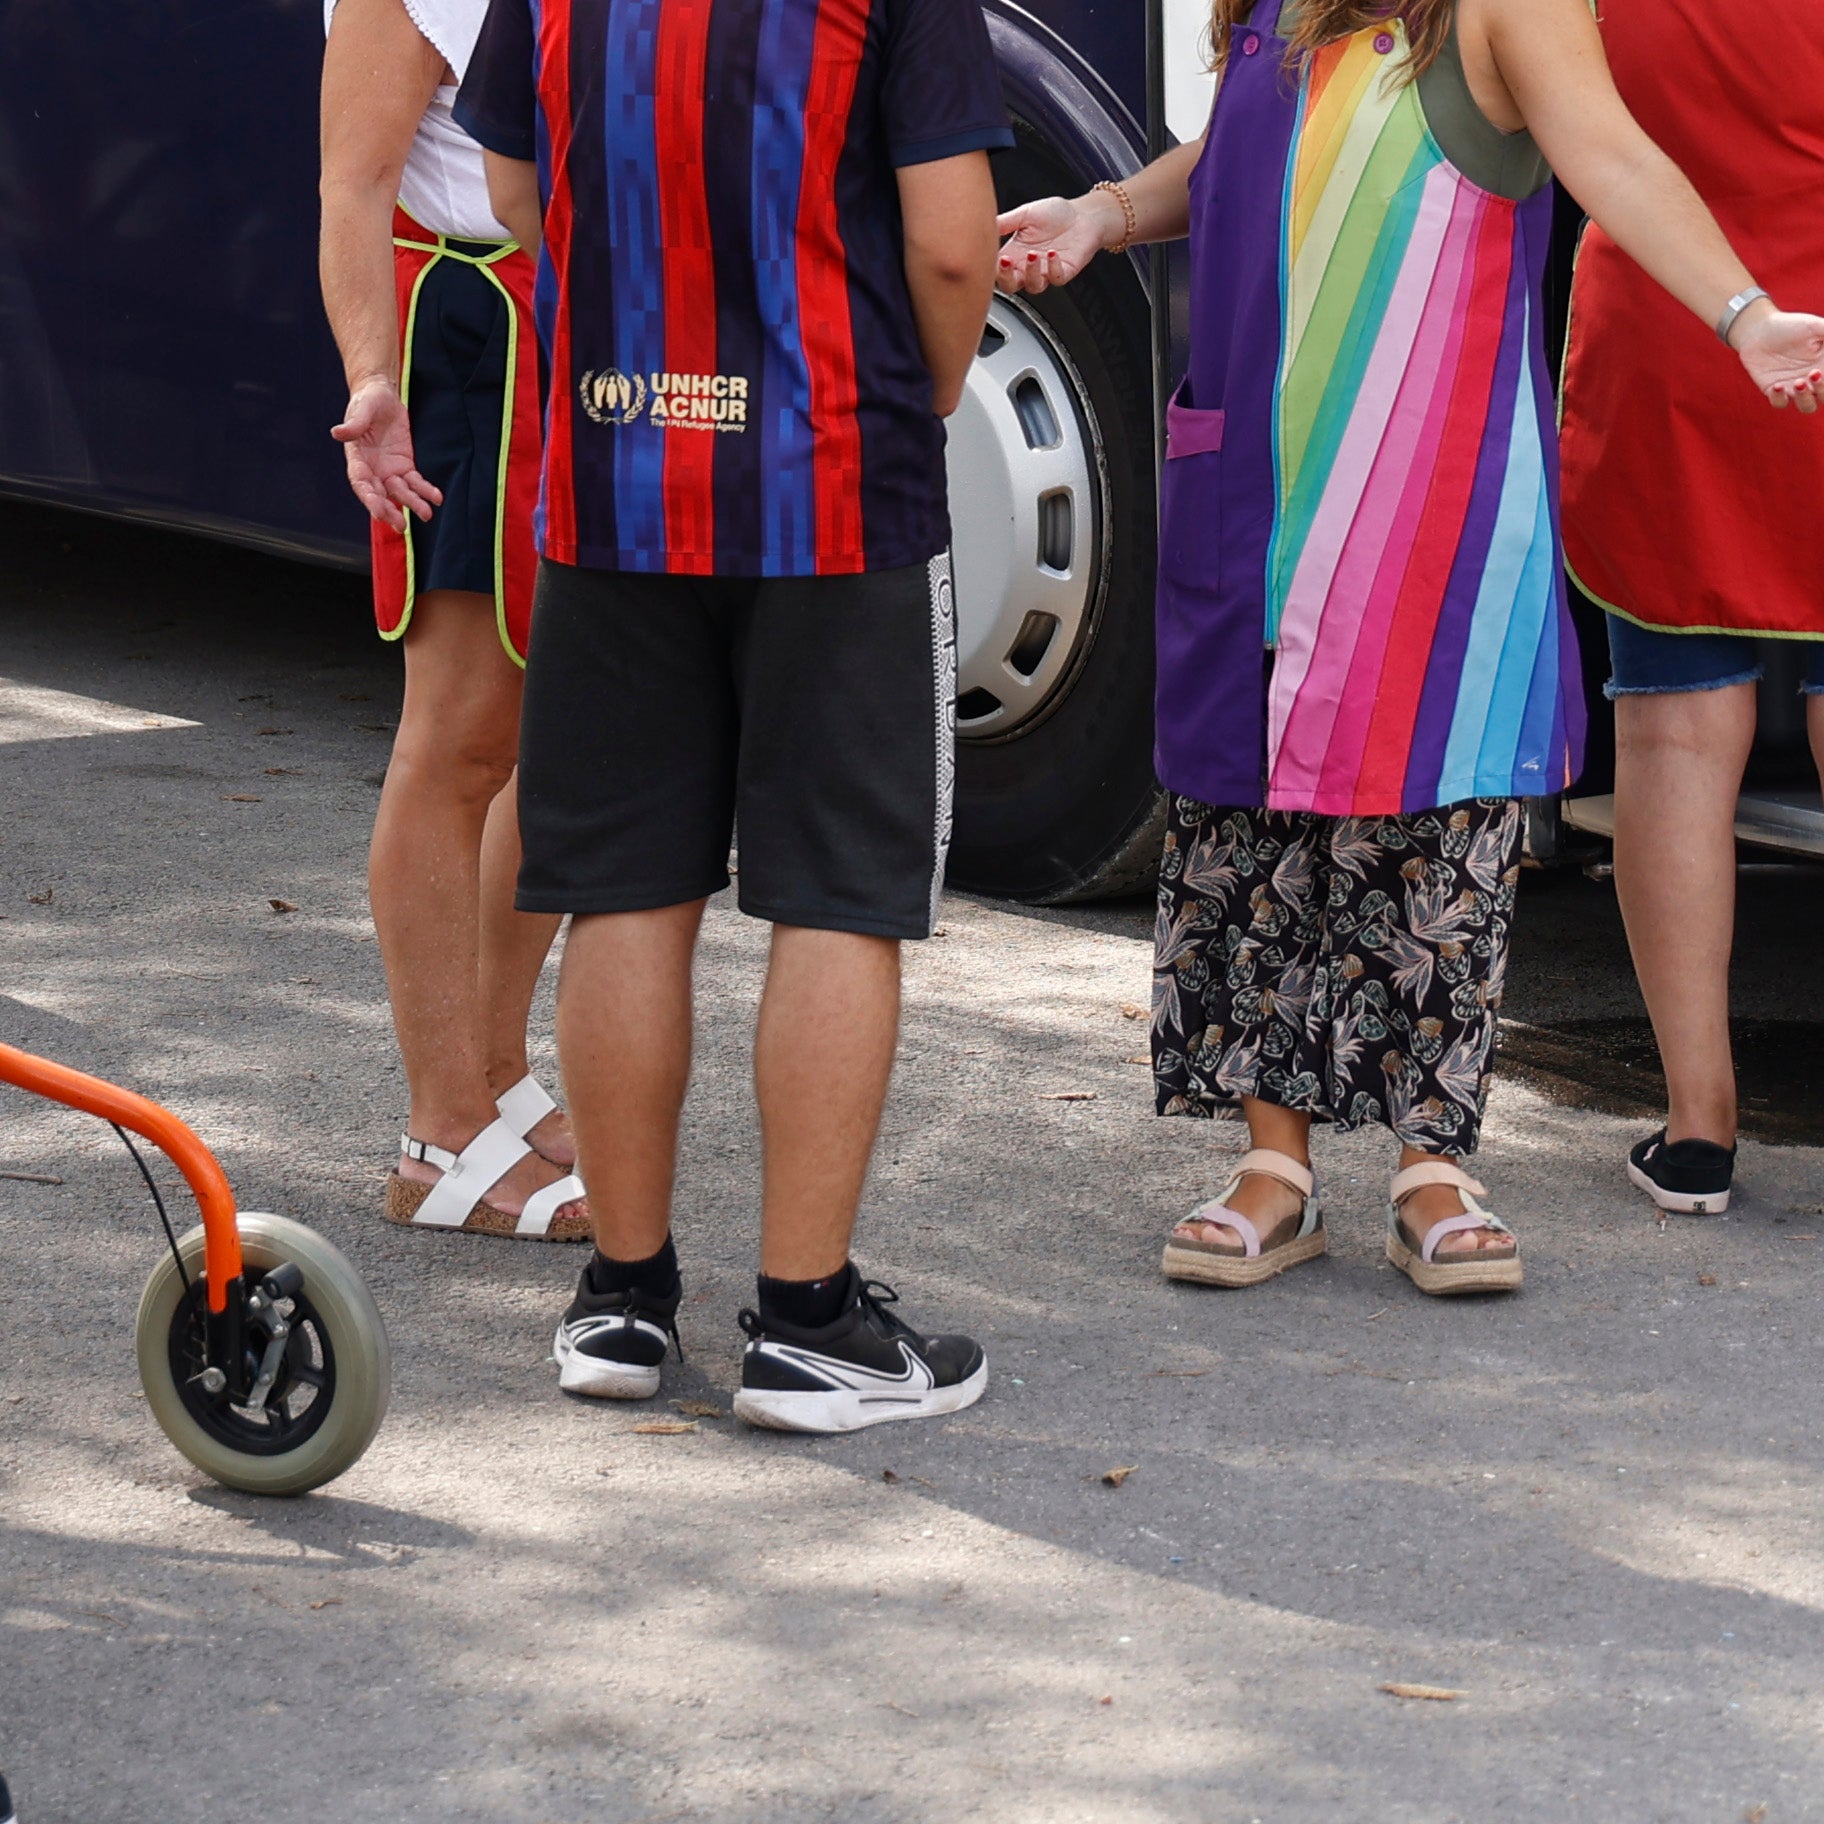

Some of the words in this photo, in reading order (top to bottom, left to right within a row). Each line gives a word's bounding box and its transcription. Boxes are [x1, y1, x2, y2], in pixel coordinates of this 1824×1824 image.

[650, 372, 749, 399] UNHCR
[649, 395, 747, 422] ACNUR
[650, 417, 666, 427] The
[681, 419, 716, 432] Refugee
[716, 421, 747, 434] Agency
